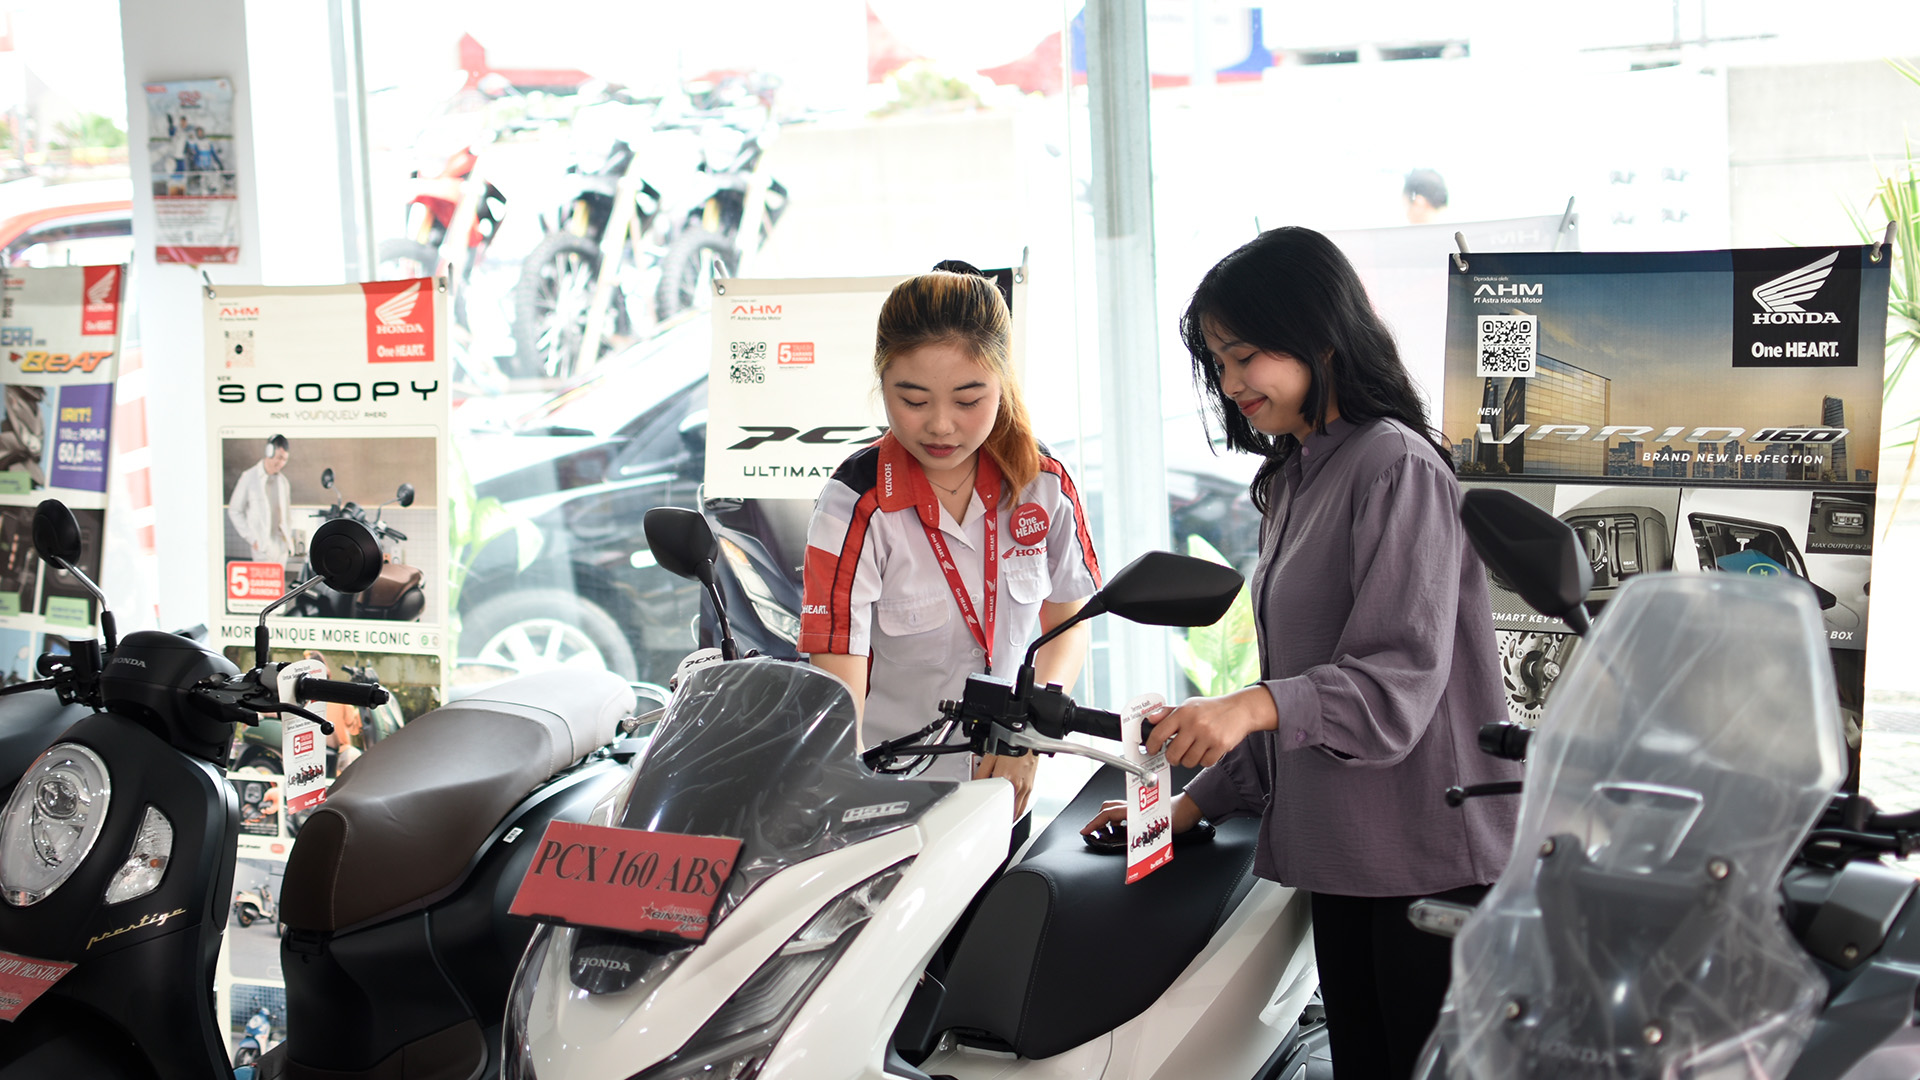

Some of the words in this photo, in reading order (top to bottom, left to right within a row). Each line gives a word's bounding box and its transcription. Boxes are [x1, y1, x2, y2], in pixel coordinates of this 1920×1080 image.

[1474, 283, 1543, 296] AHM
[219, 307, 259, 317] AHM
[731, 305, 782, 314] AHM
[1752, 312, 1842, 325] HONDA
[376, 323, 424, 335] HONDA
[377, 345, 395, 358] One
[395, 344, 426, 357] HEART.
[779, 344, 792, 363] 5
[1751, 341, 1783, 358] One
[1785, 341, 1840, 358] HEART.
[218, 380, 438, 403] SCOOPY
[1476, 407, 1502, 416] NEW
[1476, 423, 1746, 444] VARIO
[1749, 428, 1848, 444] 160
[1642, 452, 1691, 463] BRAND
[1696, 453, 1729, 463] NEW
[1735, 454, 1824, 464] PERFECTION
[743, 465, 835, 477] ULTIMAT
[884, 462, 893, 498] HONDA
[1018, 516, 1037, 528] One
[1015, 520, 1047, 538] HEART.
[1016, 546, 1048, 557] HON
[1827, 542, 1855, 550] OUTPUT
[230, 566, 249, 597] 5
[1492, 613, 1528, 622] SMART
[1529, 614, 1549, 624] KEY
[221, 626, 254, 639] MOR
[268, 627, 316, 642] UNIQUE
[322, 629, 360, 643] MORE
[365, 631, 411, 646] ICONIC
[1830, 631, 1854, 640] BOX
[1140, 787, 1147, 808] 5
[534, 840, 608, 883] PCX
[604, 849, 660, 889] 160
[656, 855, 728, 898] ABS
[86, 907, 187, 950] prestige
[577, 956, 632, 973] HONDA
